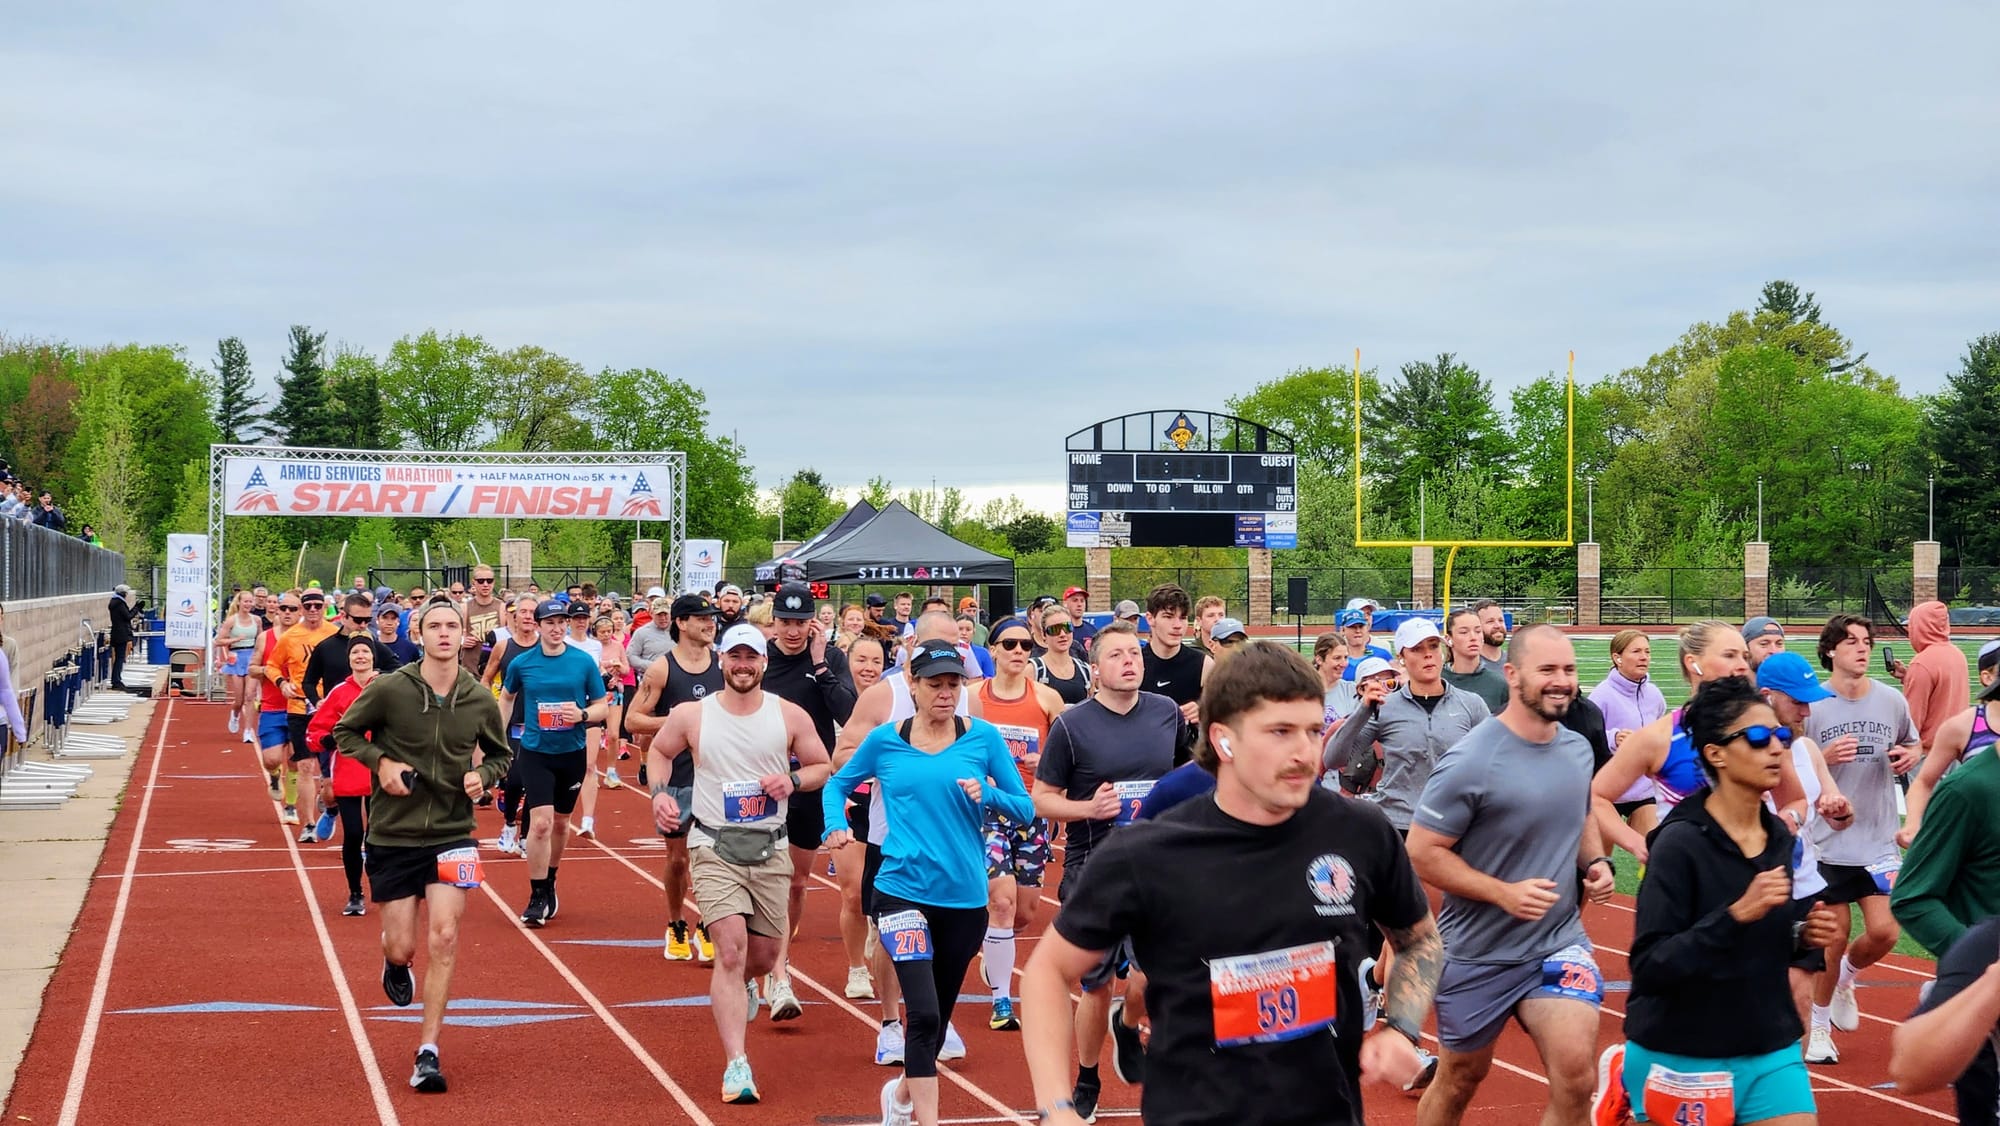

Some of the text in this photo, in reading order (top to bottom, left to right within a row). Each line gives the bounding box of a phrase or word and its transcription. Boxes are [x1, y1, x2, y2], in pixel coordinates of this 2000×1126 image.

[1071, 454, 1102, 465] HOME
[1260, 456, 1293, 467] GUEST
[280, 464, 452, 483] ARMED SERVICES MARATHON
[480, 472, 605, 482] HALF MARATHON AND 5K
[1072, 485, 1088, 493] TIME
[1107, 484, 1133, 493] DOWN
[1145, 484, 1171, 493] TO GO
[1193, 484, 1223, 494] BALL ON
[1236, 485, 1253, 494] QTR
[1276, 487, 1292, 495] TIME
[289, 482, 436, 513] START
[468, 485, 613, 516] FINISH
[1070, 493, 1088, 501] OUTS
[1276, 495, 1294, 503] OUTS
[1071, 501, 1088, 509] LEFT
[1276, 502, 1292, 510] LEFT
[551, 714, 564, 727] 75
[1820, 721, 1892, 743] BERKLEY DAYS
[1005, 739, 1028, 760] 08
[739, 796, 767, 817] 307
[458, 863, 476, 881] 67
[895, 930, 927, 955] 279
[1257, 985, 1300, 1034] 59
